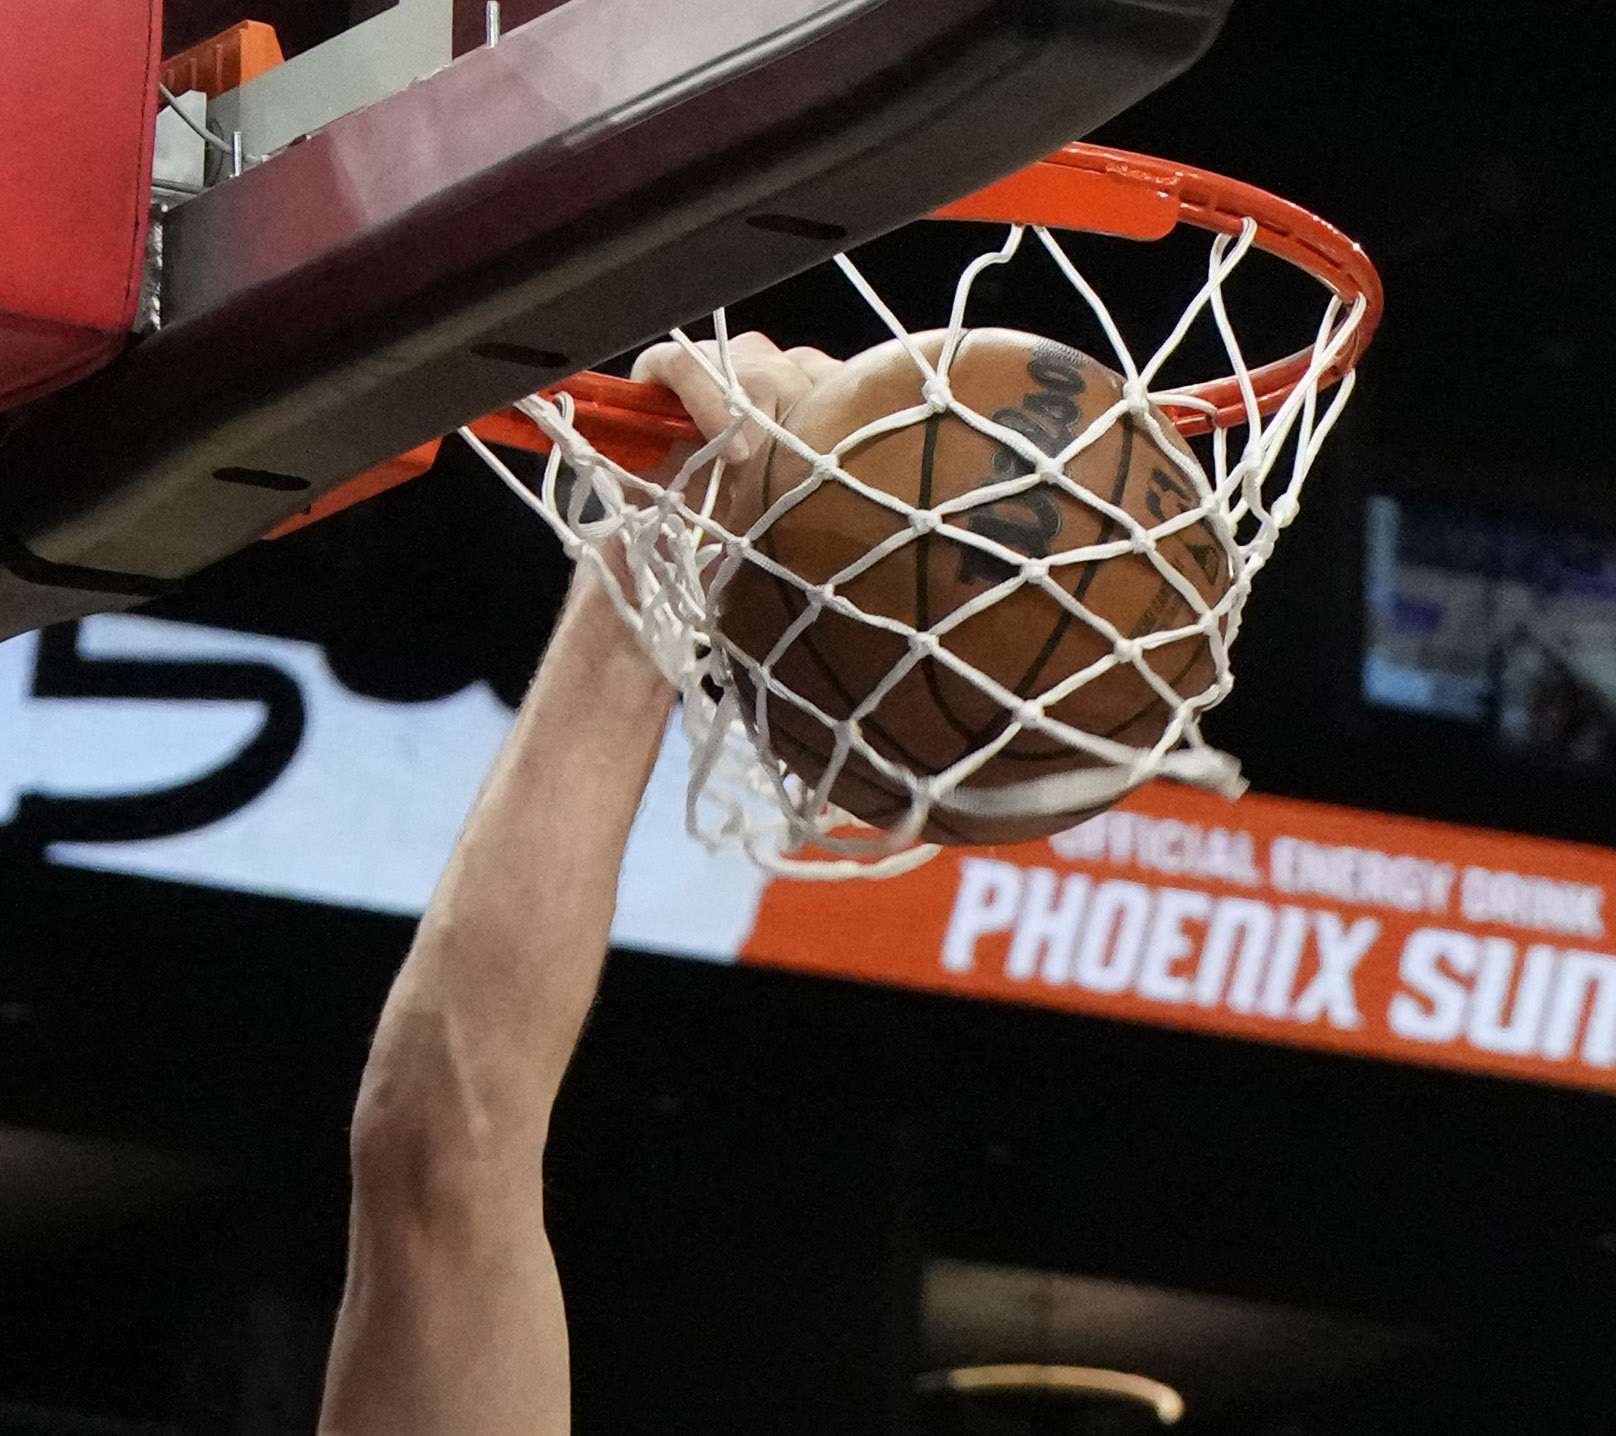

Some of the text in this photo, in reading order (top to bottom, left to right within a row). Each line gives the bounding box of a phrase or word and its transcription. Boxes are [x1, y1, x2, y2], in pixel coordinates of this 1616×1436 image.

[941, 856, 1380, 1031] PHOENIX
[1270, 835, 1456, 912] ENERGY
[1460, 866, 1608, 940] DRINK
